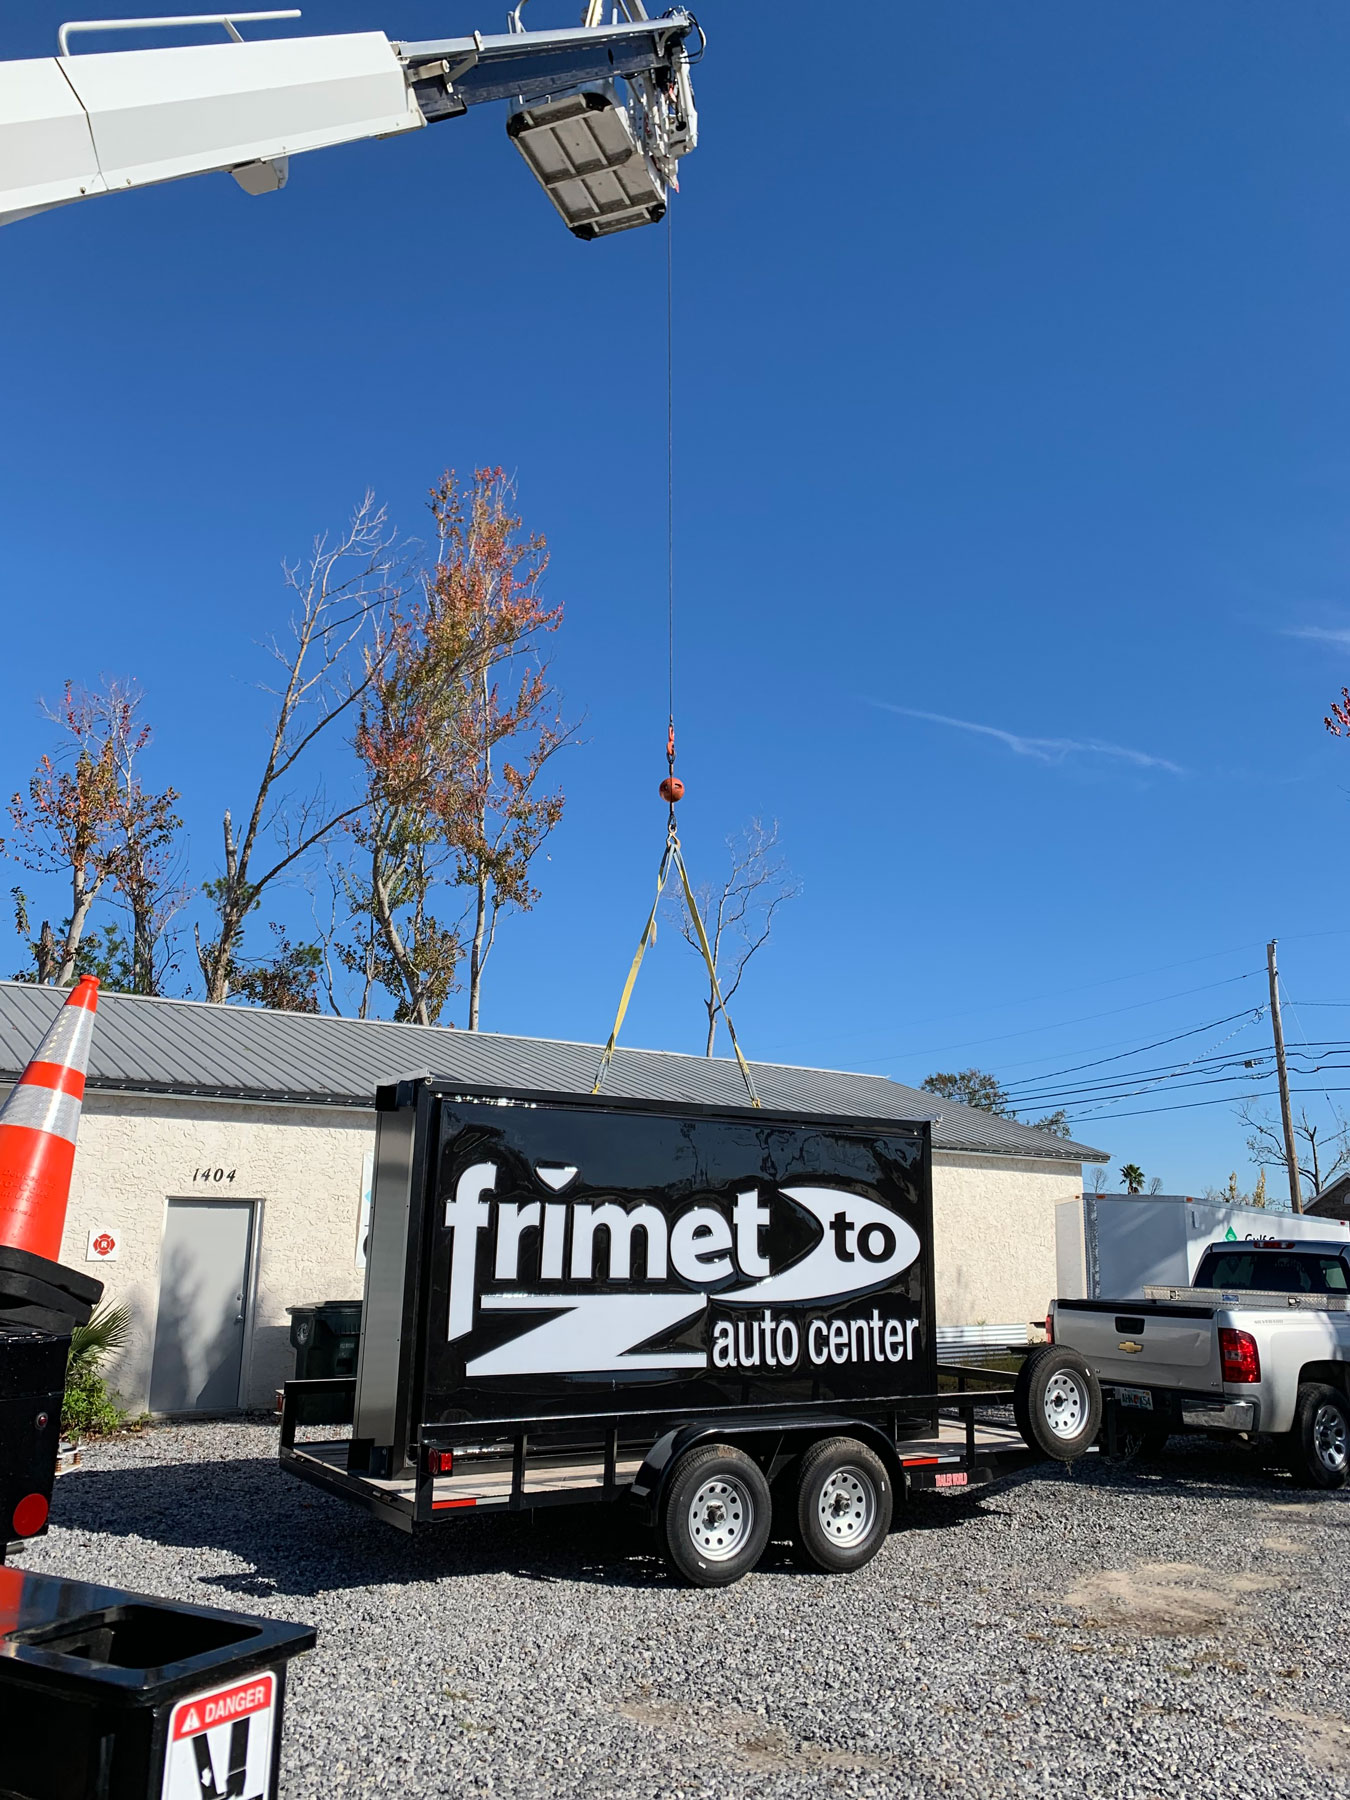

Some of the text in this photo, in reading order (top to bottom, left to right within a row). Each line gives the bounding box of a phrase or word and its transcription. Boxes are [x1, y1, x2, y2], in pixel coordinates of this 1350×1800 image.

[193, 1168, 236, 1183] 1404
[445, 1162, 897, 1342] frimet to
[712, 1308, 919, 1368] auto center
[205, 1686, 265, 1724] DANGER
